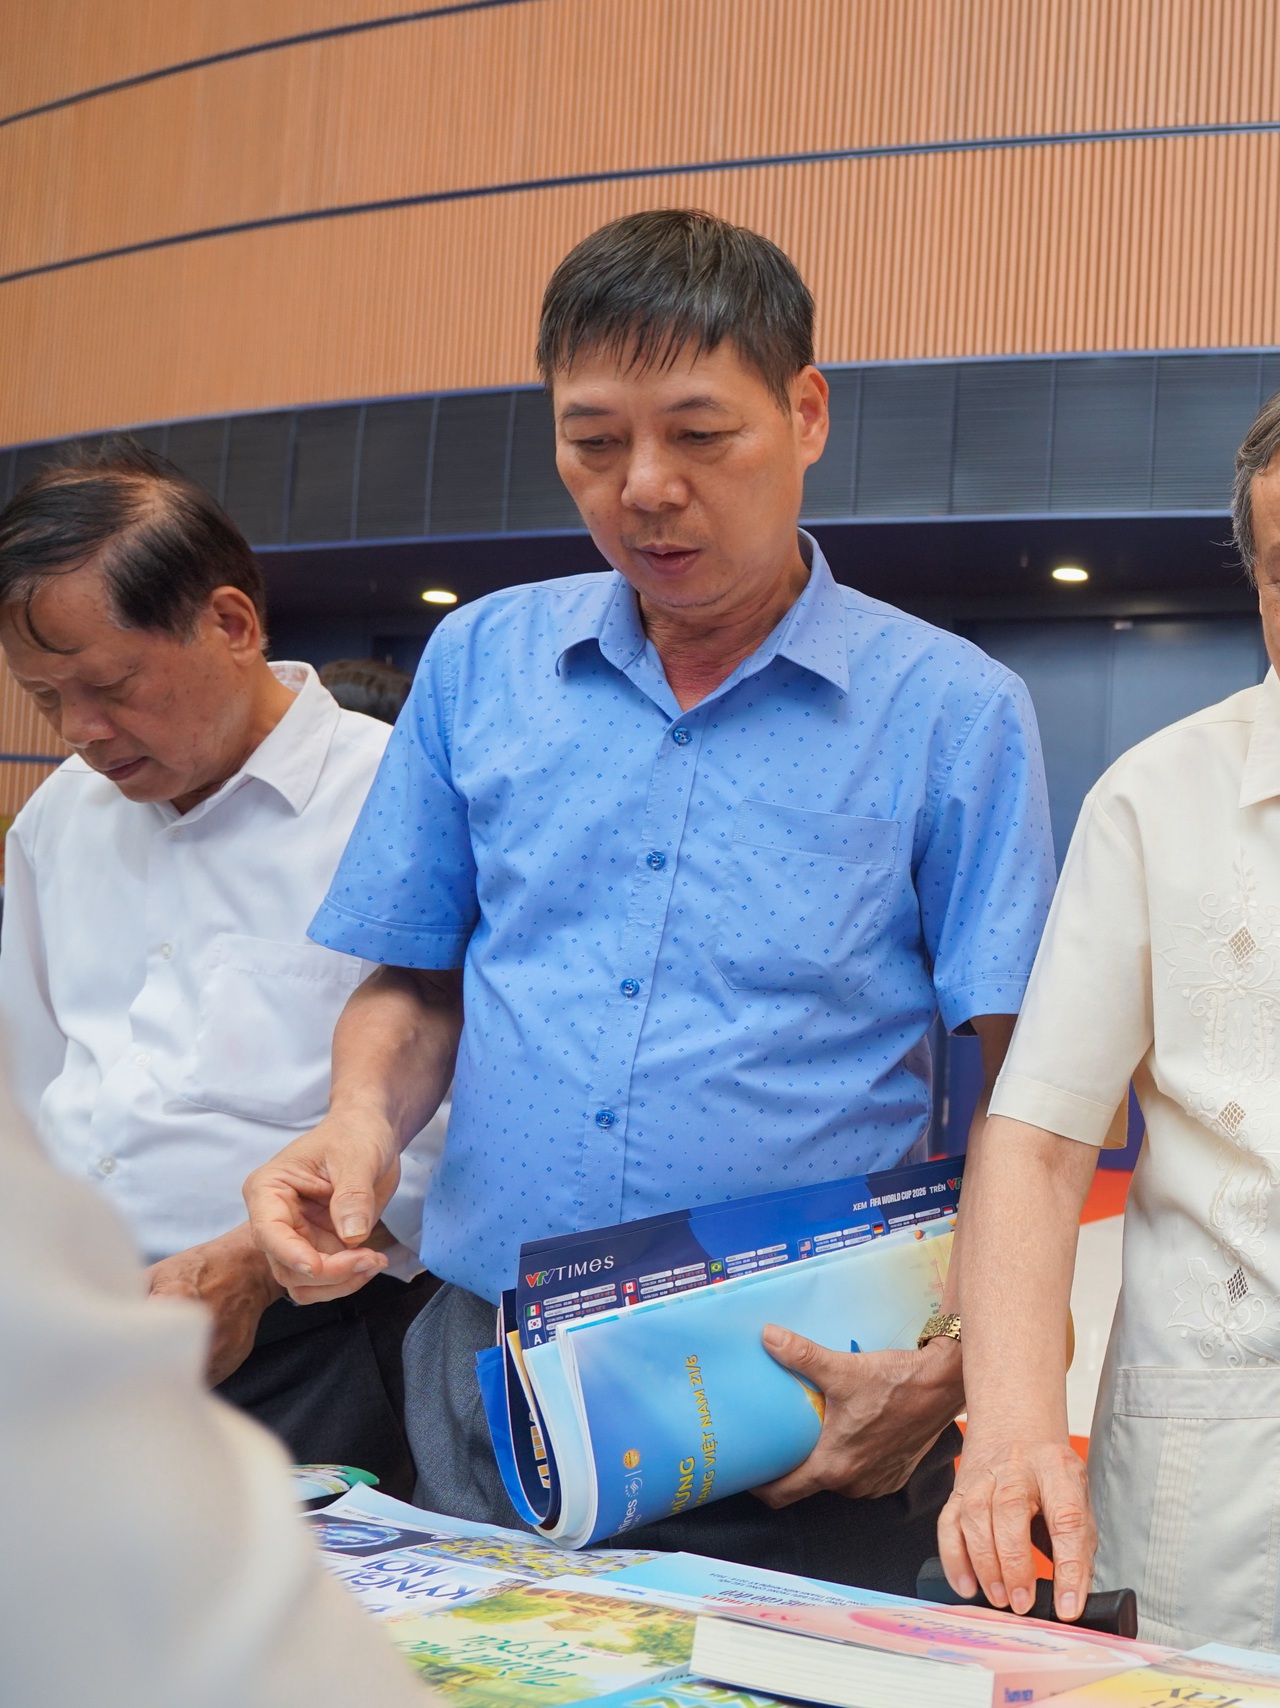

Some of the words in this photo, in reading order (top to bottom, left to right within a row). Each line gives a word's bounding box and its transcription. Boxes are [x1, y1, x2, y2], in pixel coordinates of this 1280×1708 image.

[852, 1201, 867, 1212] XEM
[869, 1197, 882, 1208] FIFA
[882, 1191, 901, 1205] WORLD
[901, 1190, 912, 1202] CUP
[912, 1187, 927, 1198] 2026
[929, 1183, 946, 1195] TRÊN
[534, 1334, 542, 1345] A
[686, 1354, 703, 1387] 21/6
[693, 1388, 713, 1429] NAM
[702, 1431, 718, 1468] VIỆT
